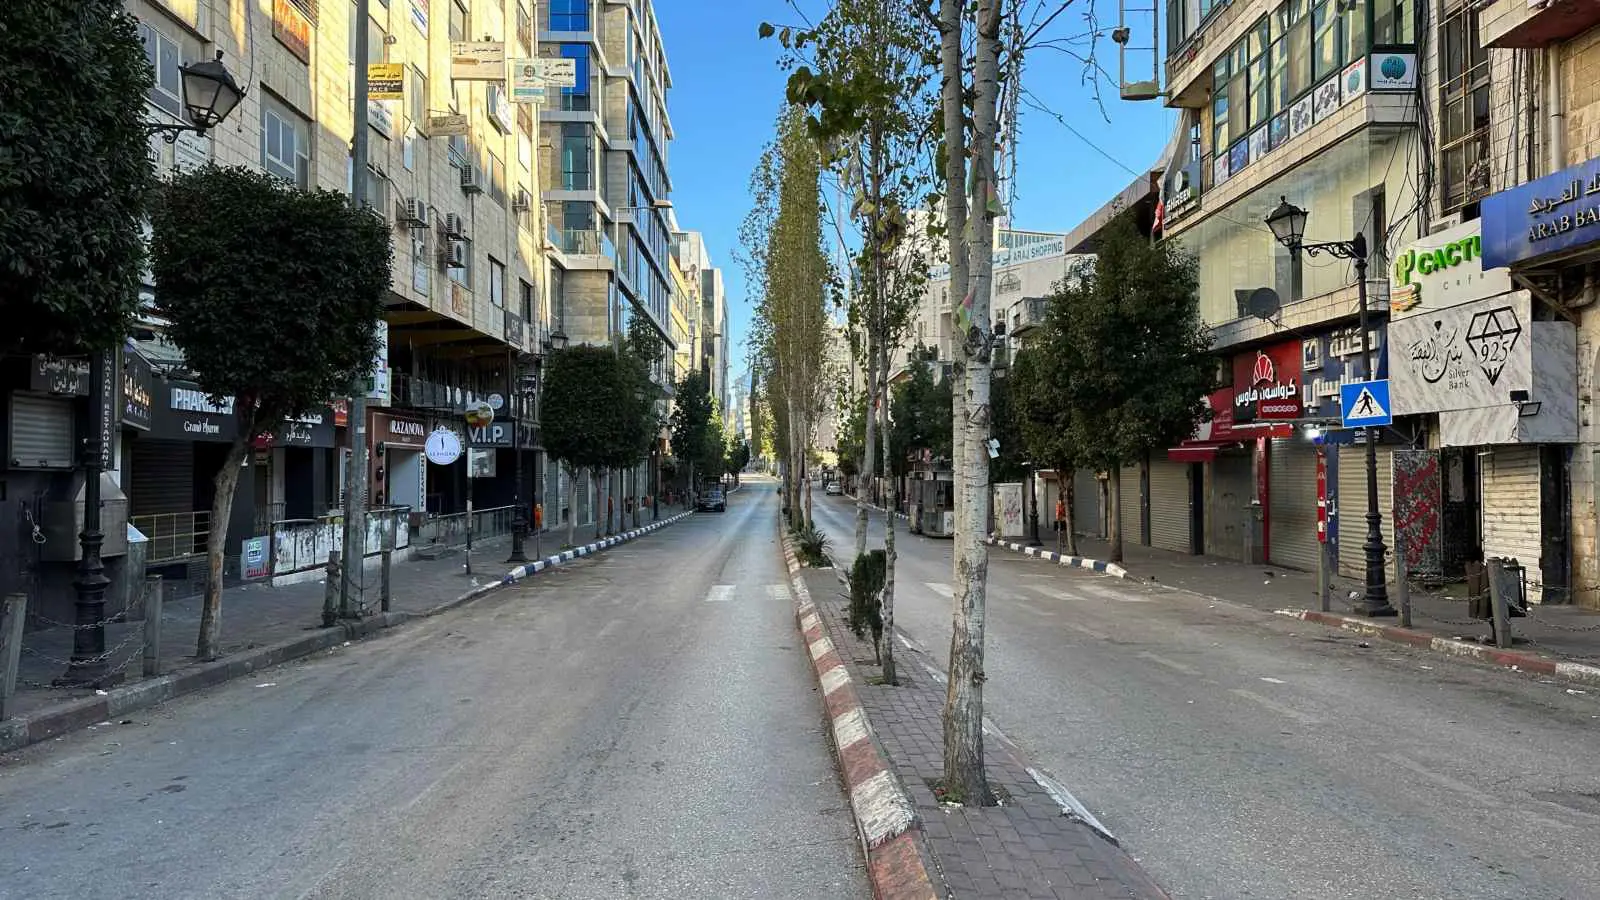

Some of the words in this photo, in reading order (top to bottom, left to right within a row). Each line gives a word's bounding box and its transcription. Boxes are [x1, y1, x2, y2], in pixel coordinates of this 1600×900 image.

[1528, 216, 1569, 241] ARAB
[1575, 204, 1600, 227] BA
[1031, 241, 1063, 257] SHOPPING
[1481, 341, 1508, 364] 925
[1449, 369, 1469, 379] Silver
[1449, 380, 1469, 390] Bank
[390, 420, 424, 437] RAZANOVA
